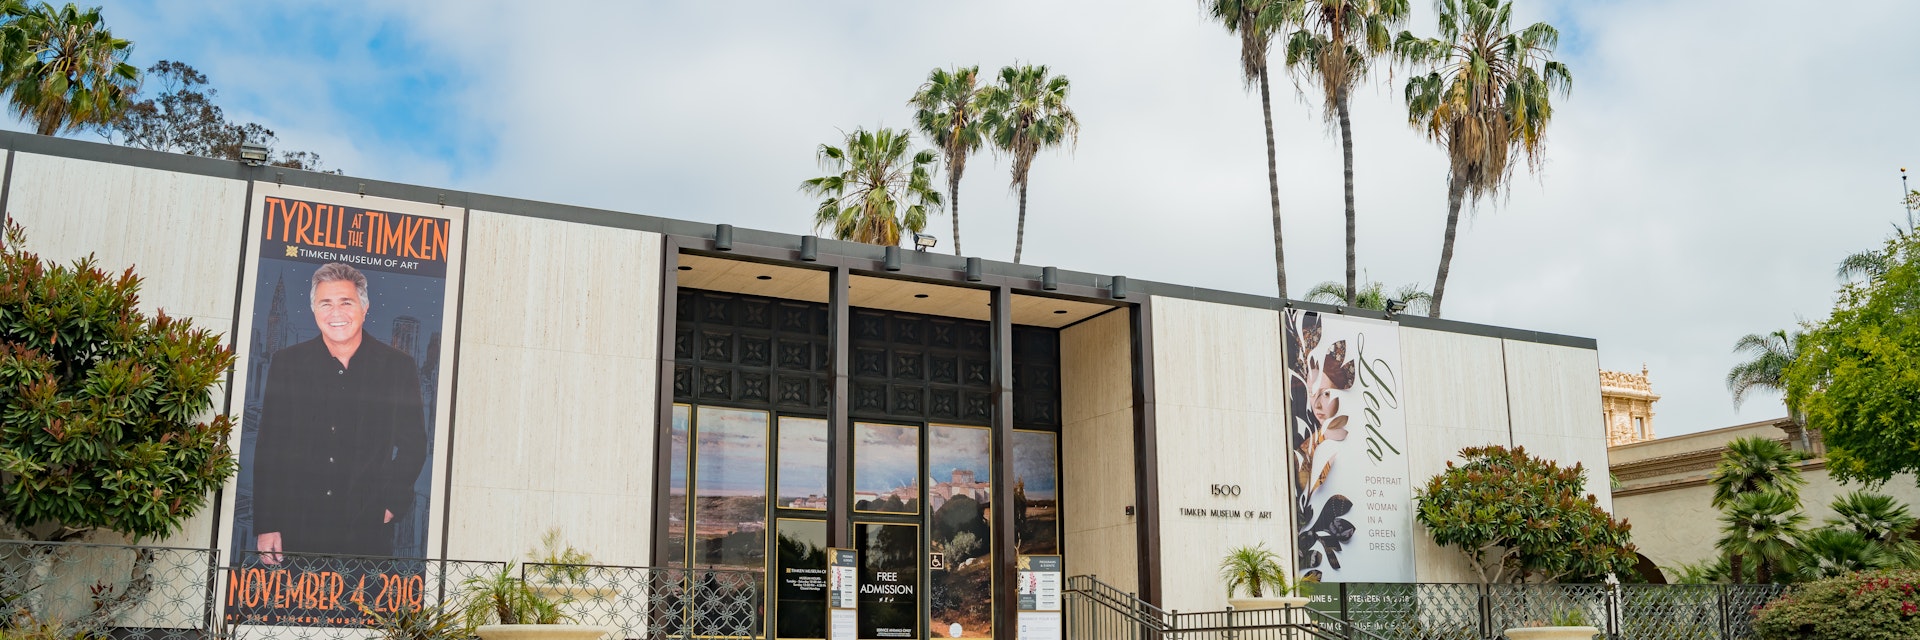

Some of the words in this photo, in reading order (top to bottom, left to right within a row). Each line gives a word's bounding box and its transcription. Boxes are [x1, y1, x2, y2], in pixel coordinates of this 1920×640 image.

[265, 197, 347, 249] TYRELL
[351, 213, 364, 229] AT
[348, 230, 364, 248] THE
[365, 211, 450, 263] TIMKEN
[300, 248, 337, 261] TIMKEN
[340, 253, 382, 266] MUSEUM
[384, 259, 398, 268] OF
[400, 261, 419, 270] ART
[1365, 475, 1402, 485] PORTRAIT
[1211, 484, 1241, 496] 1500
[1366, 489, 1377, 498] OF
[1379, 490, 1384, 498] A
[1366, 502, 1398, 511] WOMAN
[1179, 507, 1207, 517] TIMKEN
[1210, 509, 1241, 518] MUSEUM
[1244, 510, 1254, 519] OF
[1259, 511, 1272, 519] ART
[1367, 515, 1376, 524] IN
[1378, 516, 1383, 524] A
[1368, 529, 1396, 538] GREEN
[1369, 542, 1396, 551] DRESS
[876, 571, 898, 582] FREE
[228, 567, 346, 611] NOVEMBER
[374, 573, 424, 613] 2018
[860, 583, 913, 595] ADMISSION
